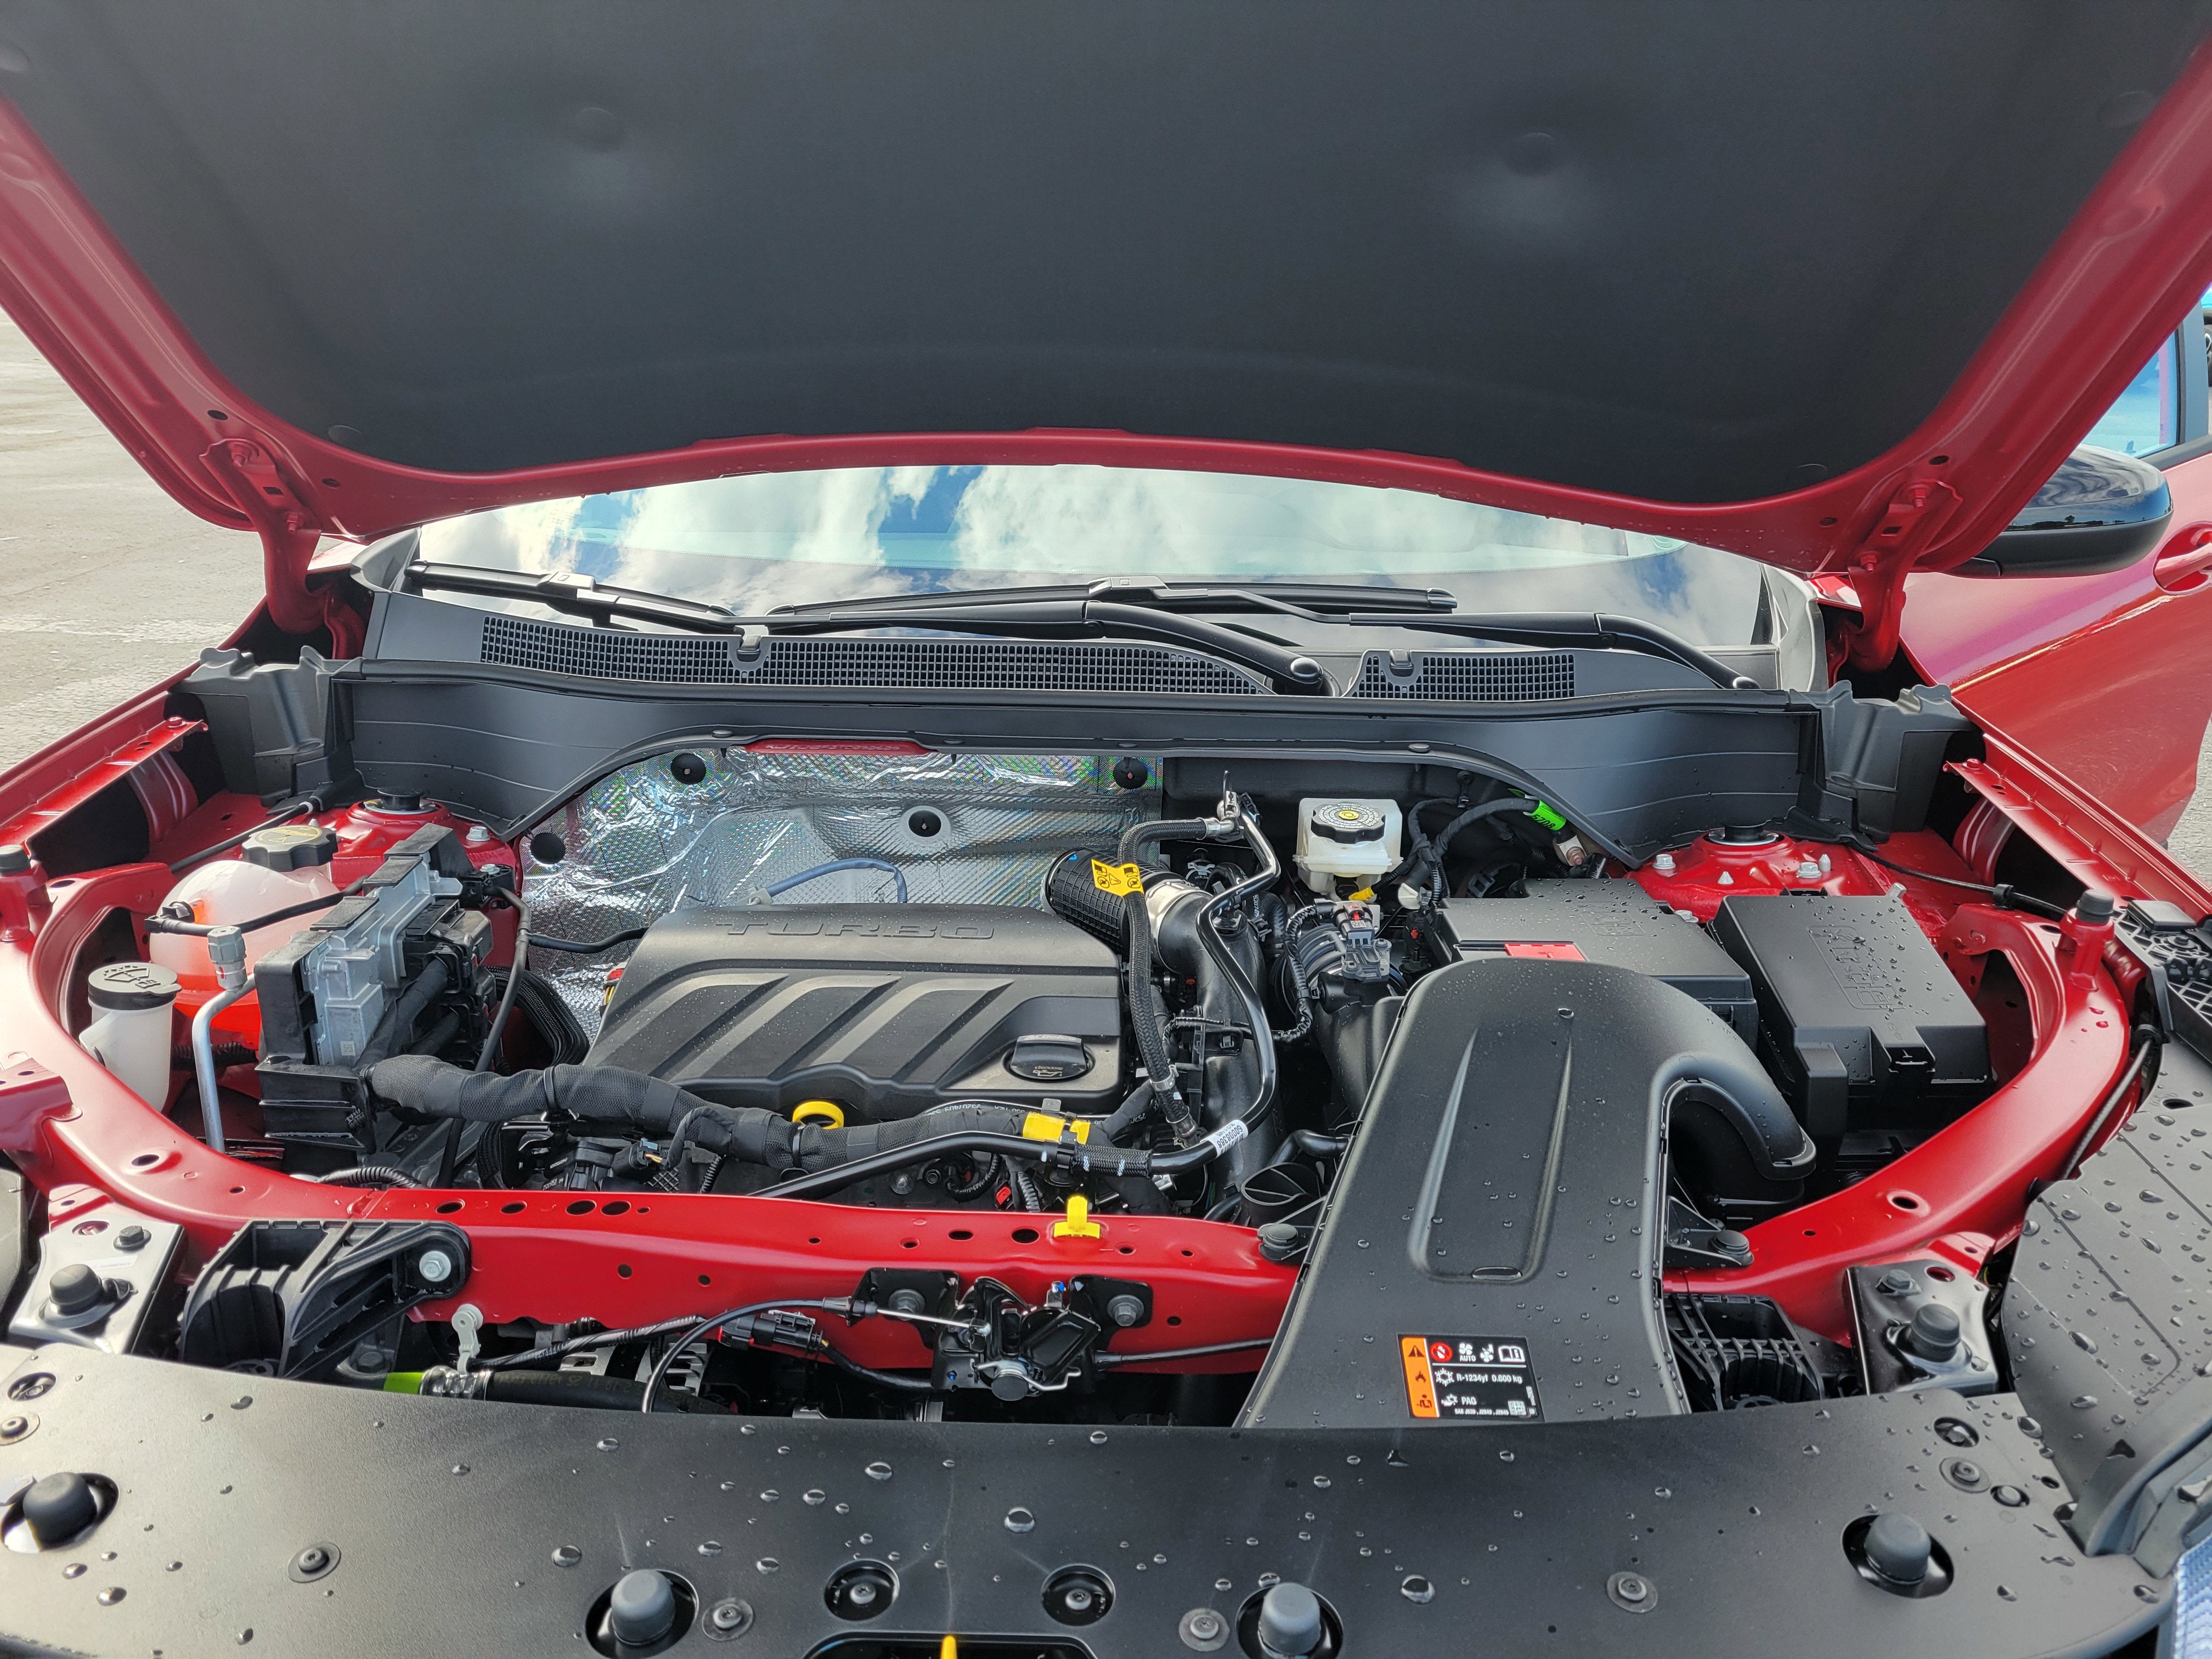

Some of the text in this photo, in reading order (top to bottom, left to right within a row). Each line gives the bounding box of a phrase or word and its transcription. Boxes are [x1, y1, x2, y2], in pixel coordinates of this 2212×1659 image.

[715, 922, 995, 940] TURBO
[1217, 1125, 1243, 1148] 60008388
[1456, 1373, 1488, 1384] R-1234yf
[1513, 1375, 1522, 1384] kg
[1461, 1396, 1477, 1405] PAG
